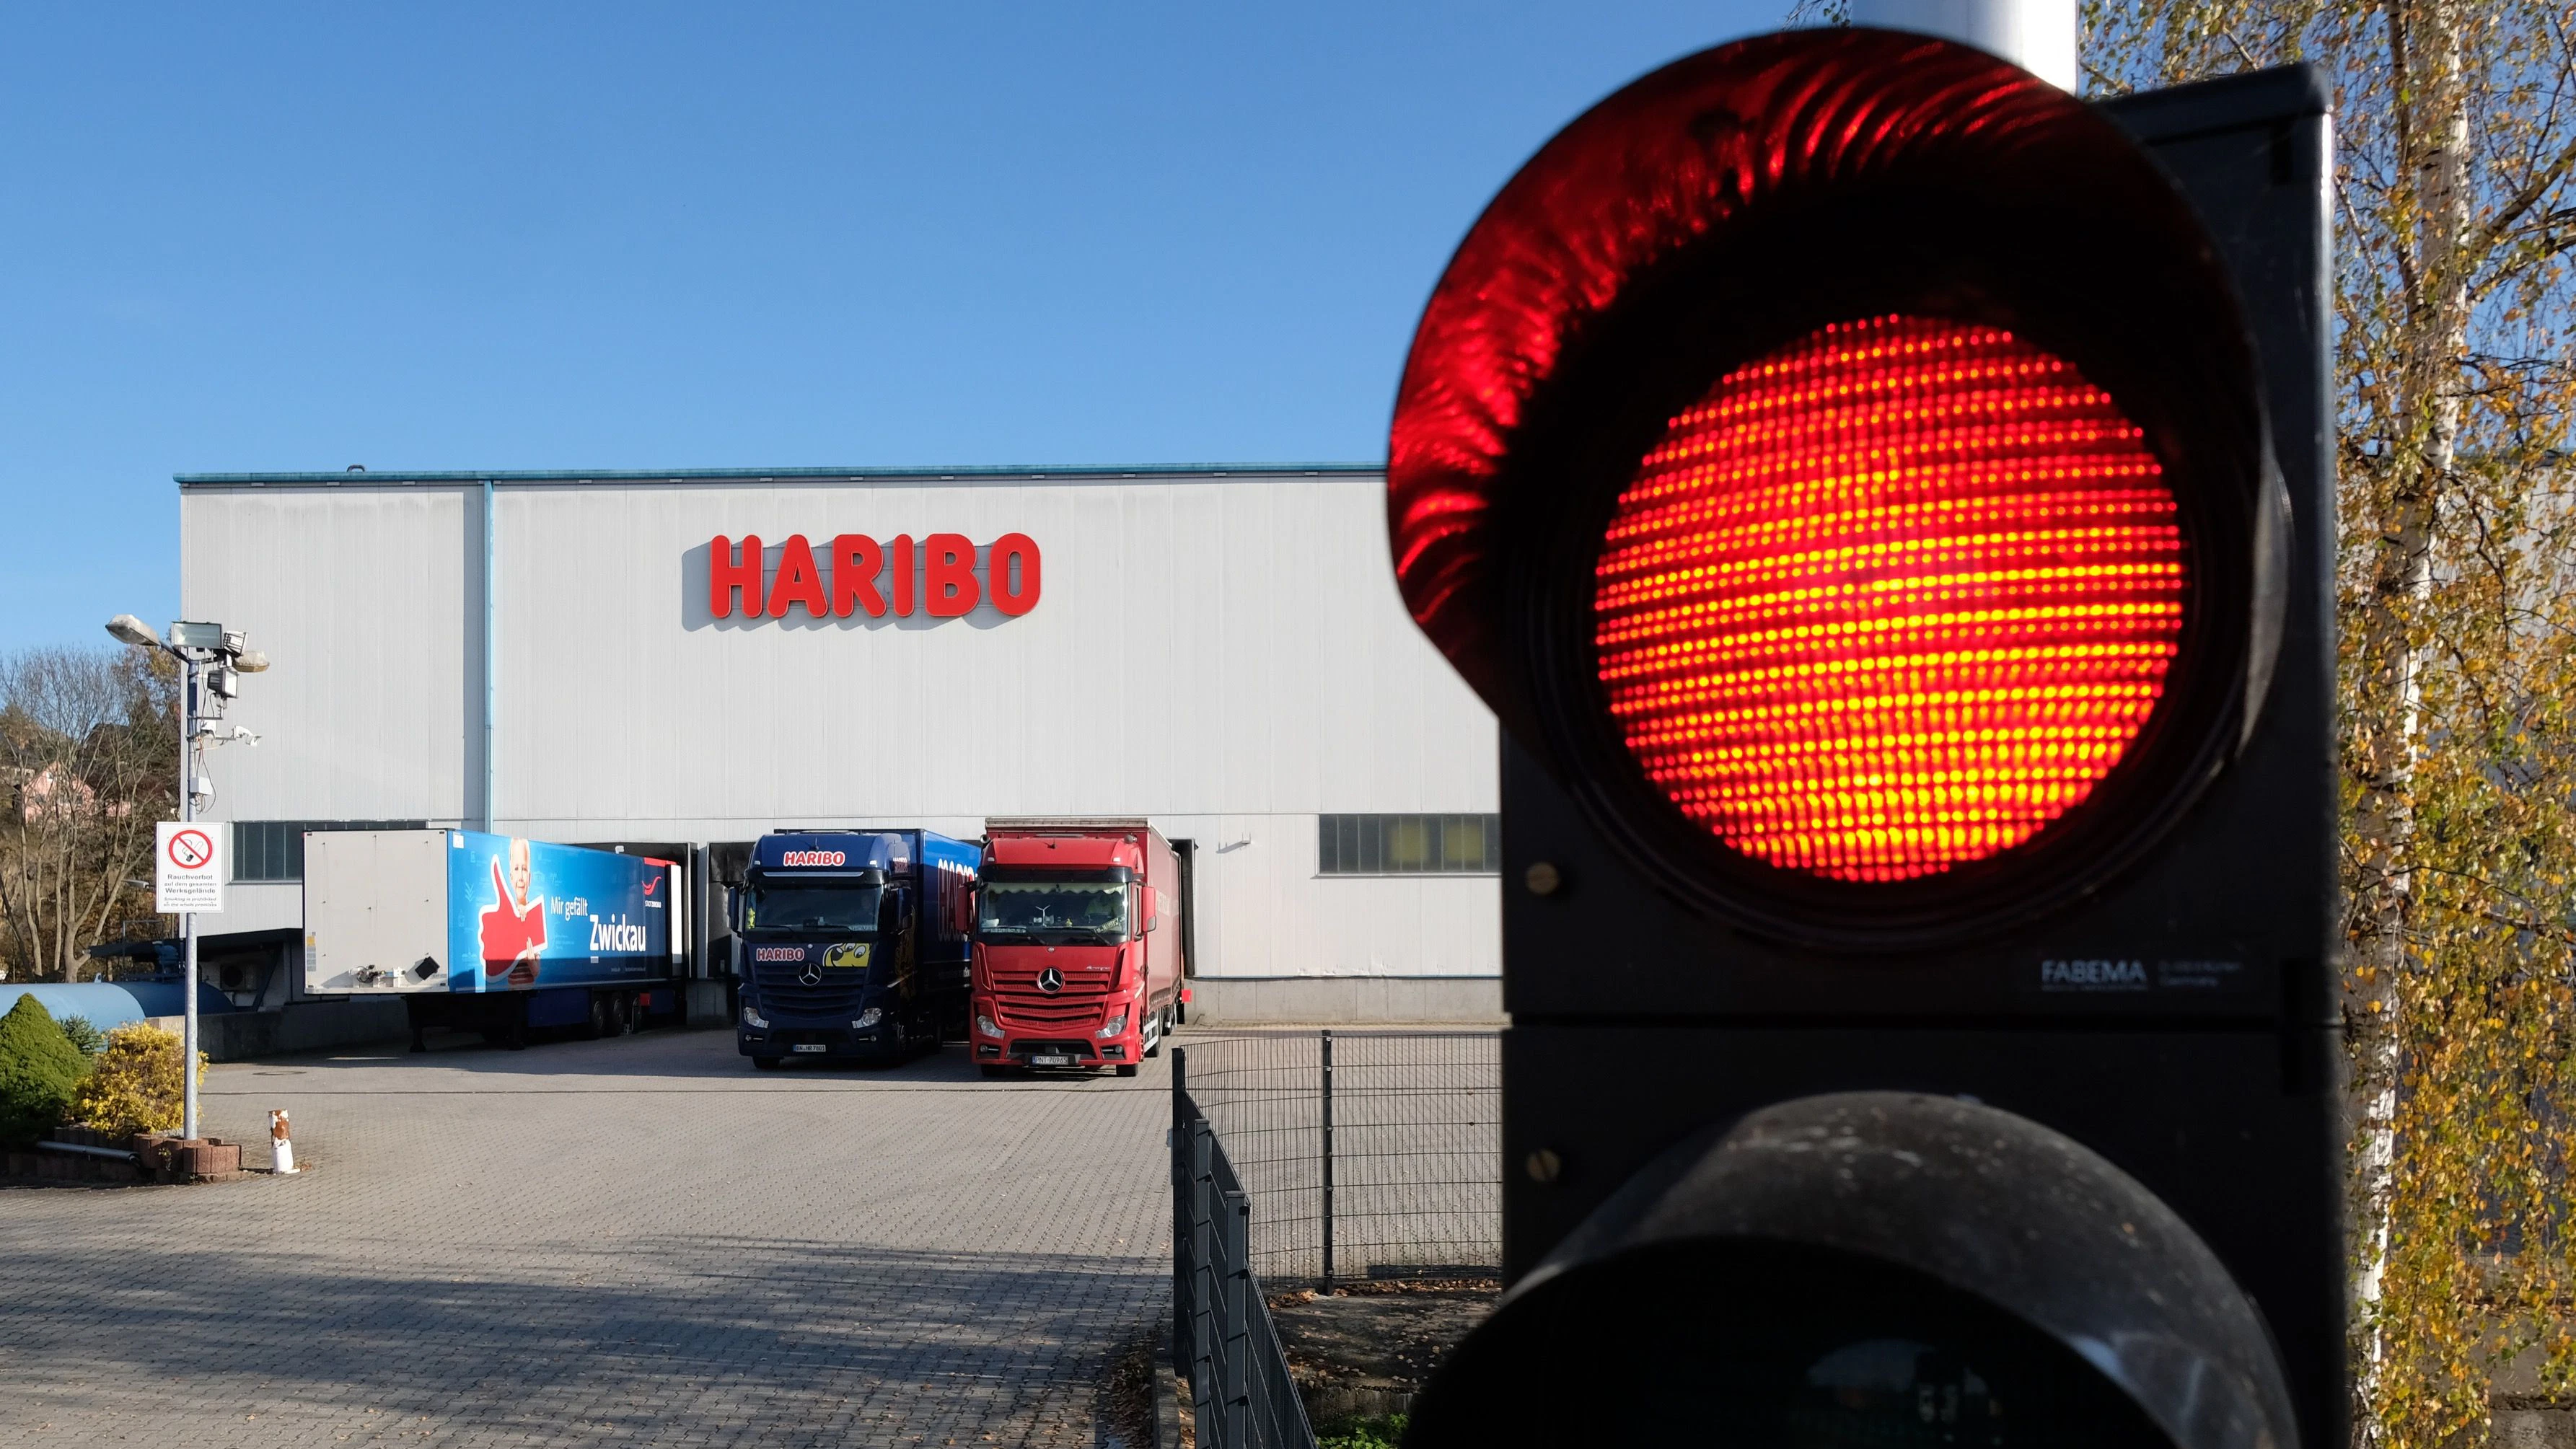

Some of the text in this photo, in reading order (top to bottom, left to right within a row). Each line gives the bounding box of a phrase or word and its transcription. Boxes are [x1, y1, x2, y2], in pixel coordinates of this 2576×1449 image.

[710, 533, 1041, 617] HARIBO
[784, 851, 845, 866] HARIBO
[551, 896, 588, 921] Mir gefällt
[589, 913, 646, 952] Zwickau
[756, 948, 805, 961] HARIBO
[2041, 959, 2148, 983] FABEMA
